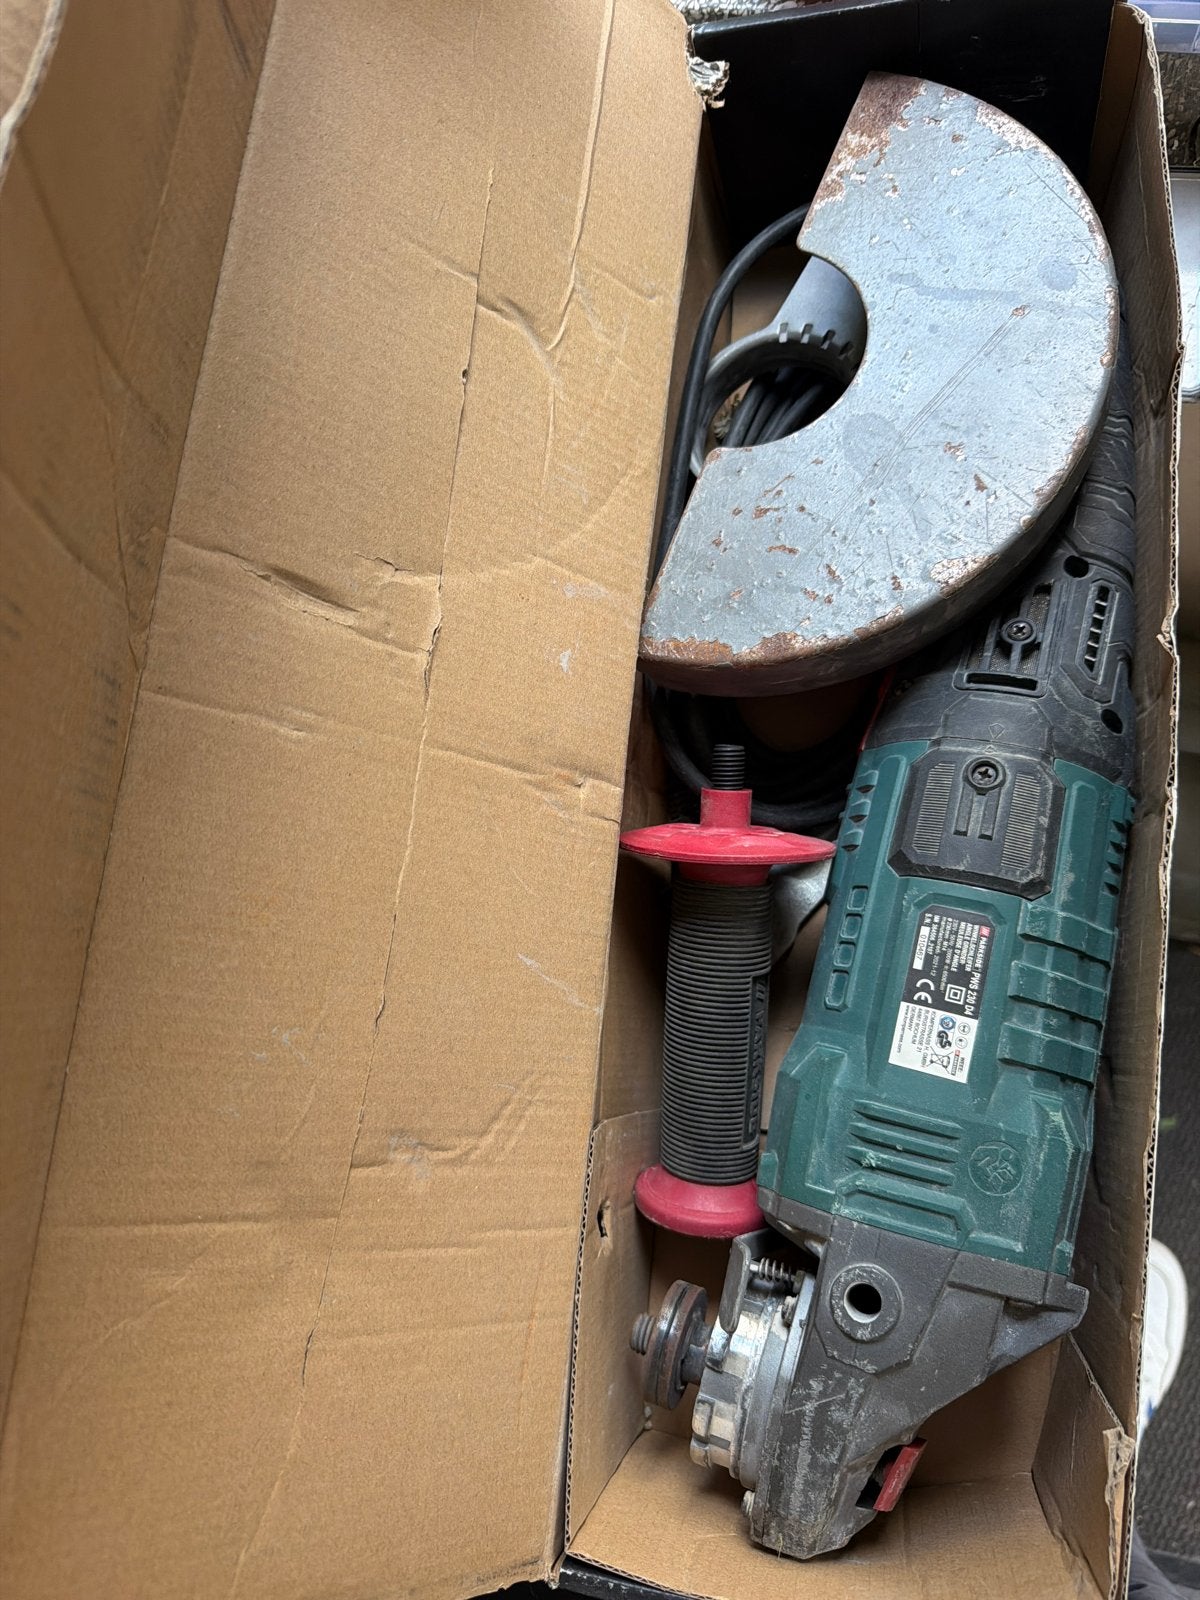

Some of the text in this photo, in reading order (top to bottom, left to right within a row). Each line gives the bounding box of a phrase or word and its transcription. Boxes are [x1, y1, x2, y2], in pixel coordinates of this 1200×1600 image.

[950, 921, 965, 972] MEULEUSE D'ANGLE
[959, 922, 972, 964] ANGLE GRINDER
[964, 923, 979, 971] WINKELSCHLEIFER
[974, 936, 987, 968] PARKSIDE
[963, 971, 980, 1015] PWS 230 D4
